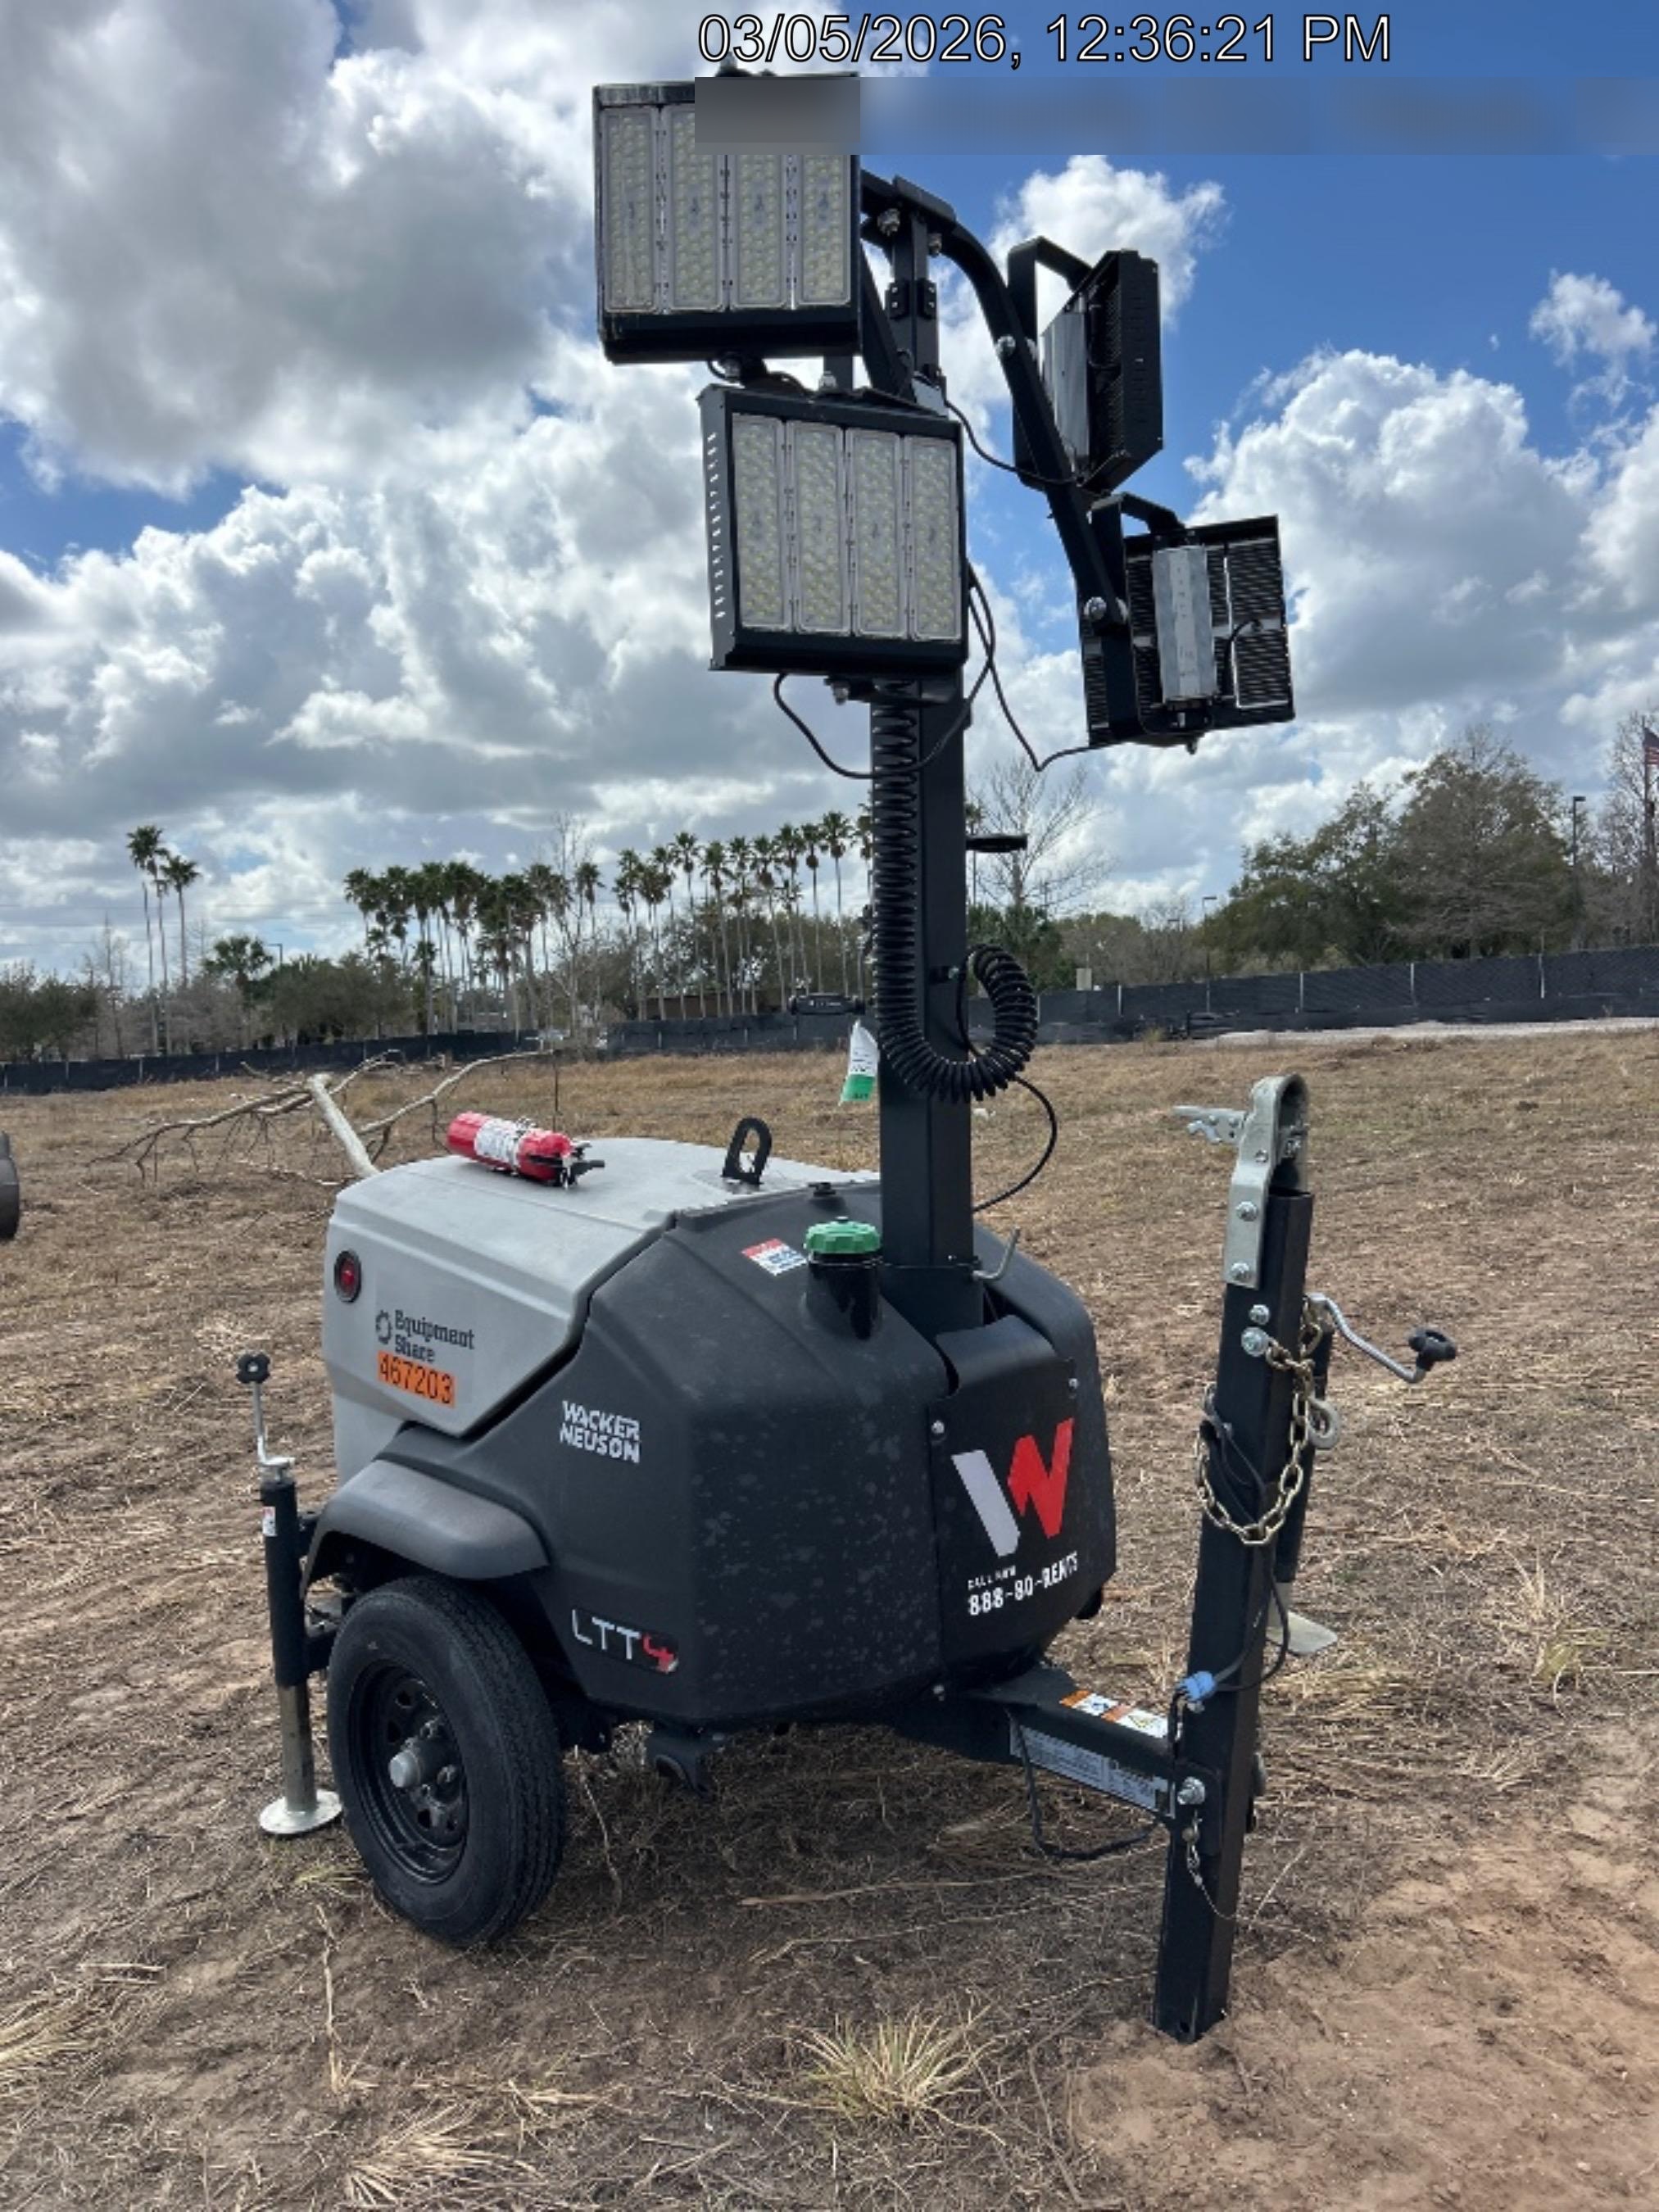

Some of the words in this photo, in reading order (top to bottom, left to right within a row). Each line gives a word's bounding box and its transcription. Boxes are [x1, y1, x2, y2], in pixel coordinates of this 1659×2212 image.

[395, 1309, 474, 1350] Equipment
[395, 1334, 435, 1363] Share
[380, 1353, 452, 1404] 467203
[562, 1400, 640, 1441] WACKER
[560, 1422, 640, 1463] NEUSON
[571, 1609, 675, 1675] LTT4
